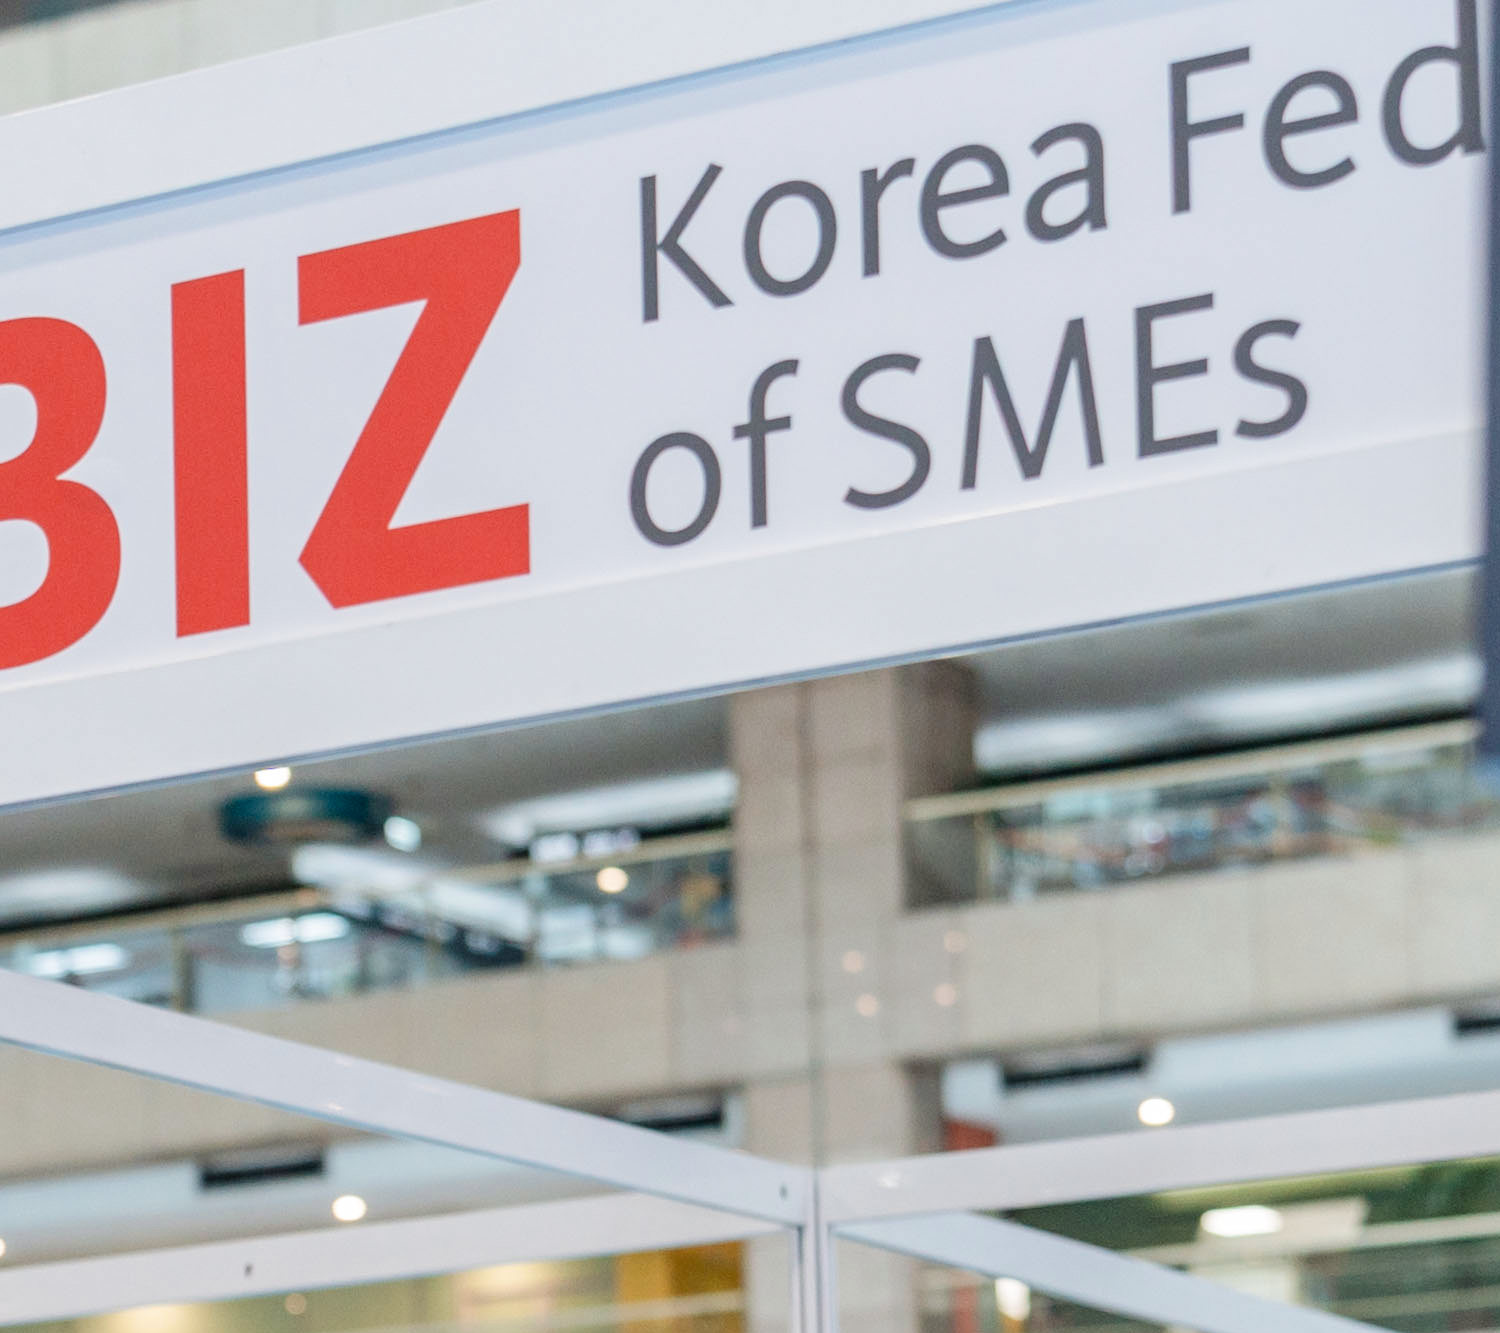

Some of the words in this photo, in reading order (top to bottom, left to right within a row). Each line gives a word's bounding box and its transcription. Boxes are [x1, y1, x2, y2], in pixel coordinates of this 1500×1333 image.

[641, 123, 1106, 321] Korea
[631, 360, 798, 546] of
[842, 294, 1307, 508] SMEs
